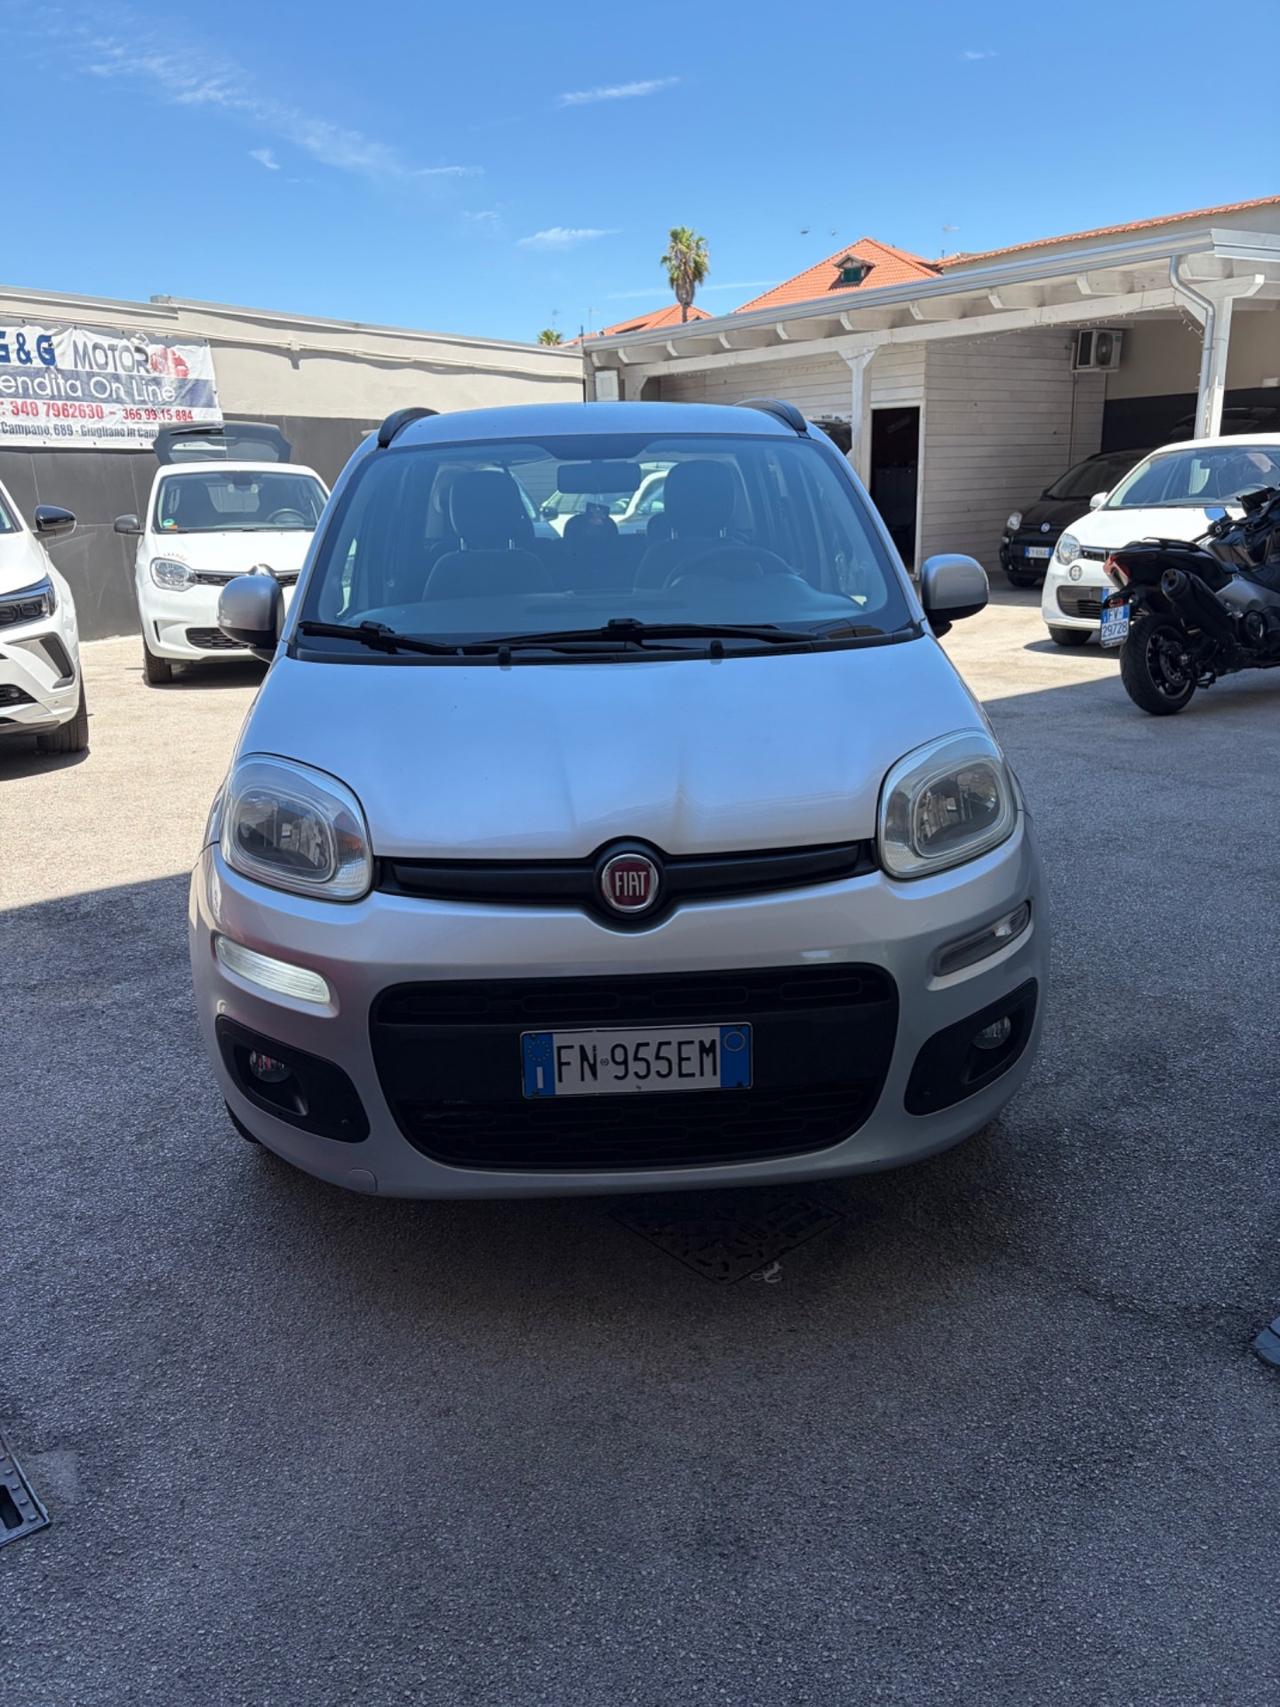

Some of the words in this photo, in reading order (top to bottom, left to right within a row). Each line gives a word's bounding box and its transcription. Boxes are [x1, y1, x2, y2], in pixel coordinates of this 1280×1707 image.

[0, 372, 82, 397] endita
[90, 377, 128, 400] On
[132, 380, 176, 402] Line
[10, 400, 39, 417] 348
[42, 402, 104, 419] 7962630
[123, 408, 142, 420] 366
[175, 409, 193, 421] 884
[1102, 621, 1127, 638] 29728
[614, 871, 648, 897] FIAT
